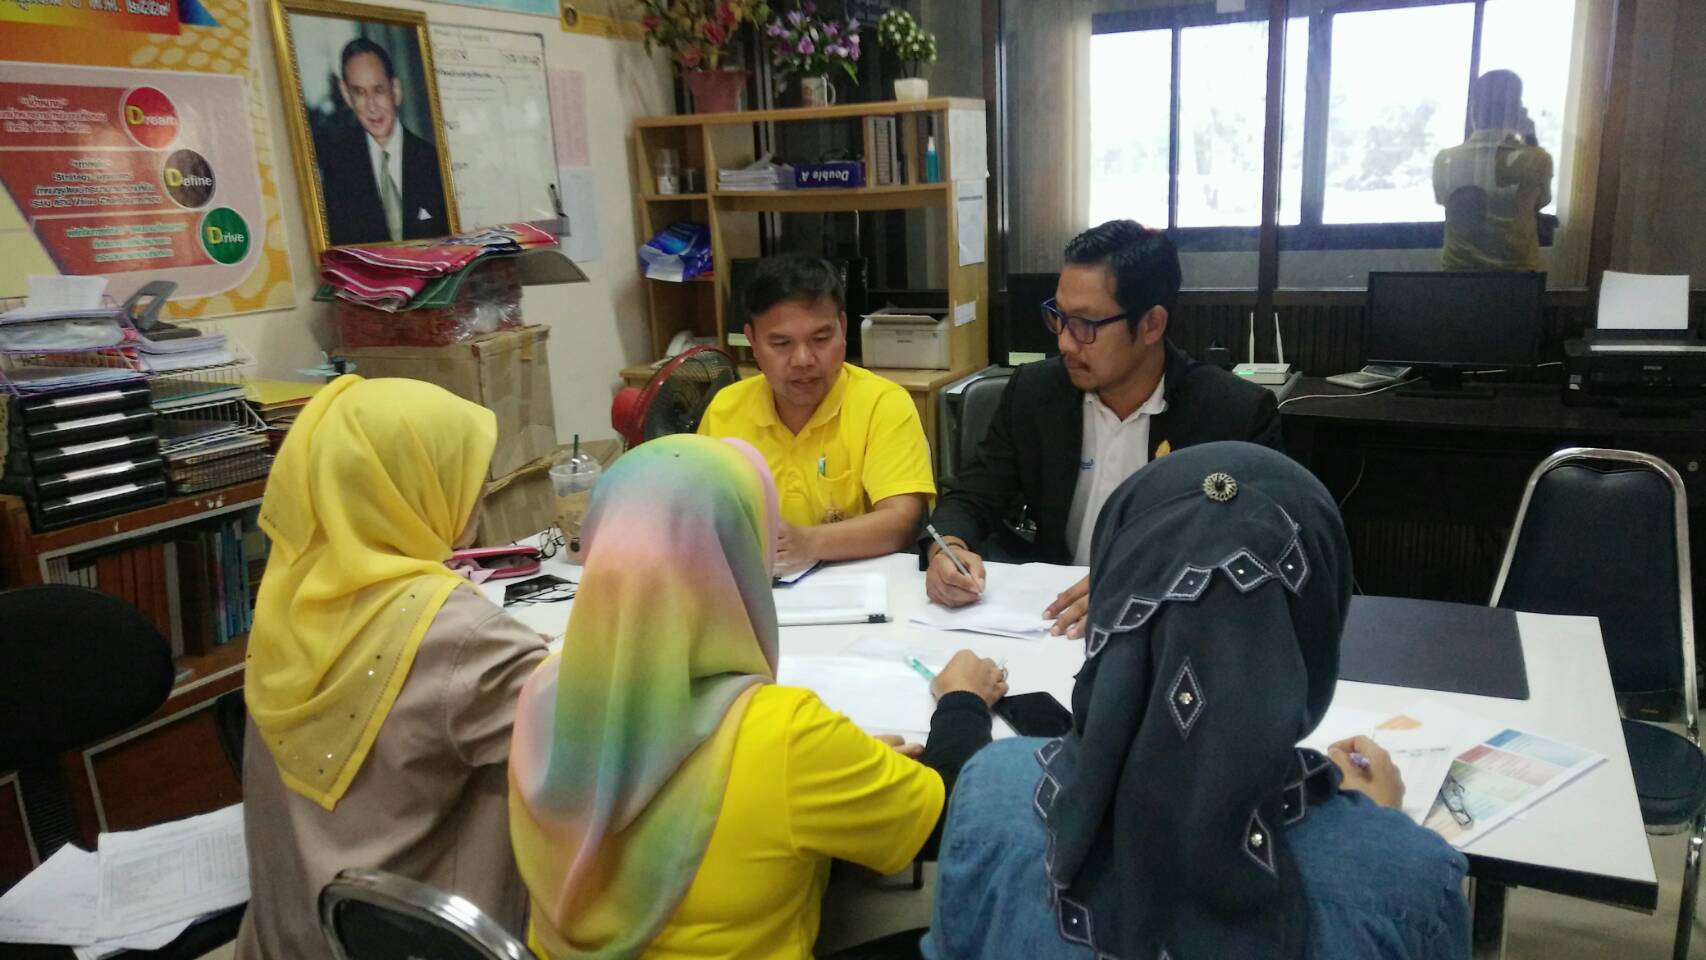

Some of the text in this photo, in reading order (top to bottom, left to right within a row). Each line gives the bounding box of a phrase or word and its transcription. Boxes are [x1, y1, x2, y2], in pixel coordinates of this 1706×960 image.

[127, 105, 178, 125] Dream
[164, 168, 212, 187] Define
[800, 170, 849, 182] Double A
[207, 225, 245, 244] Drive
